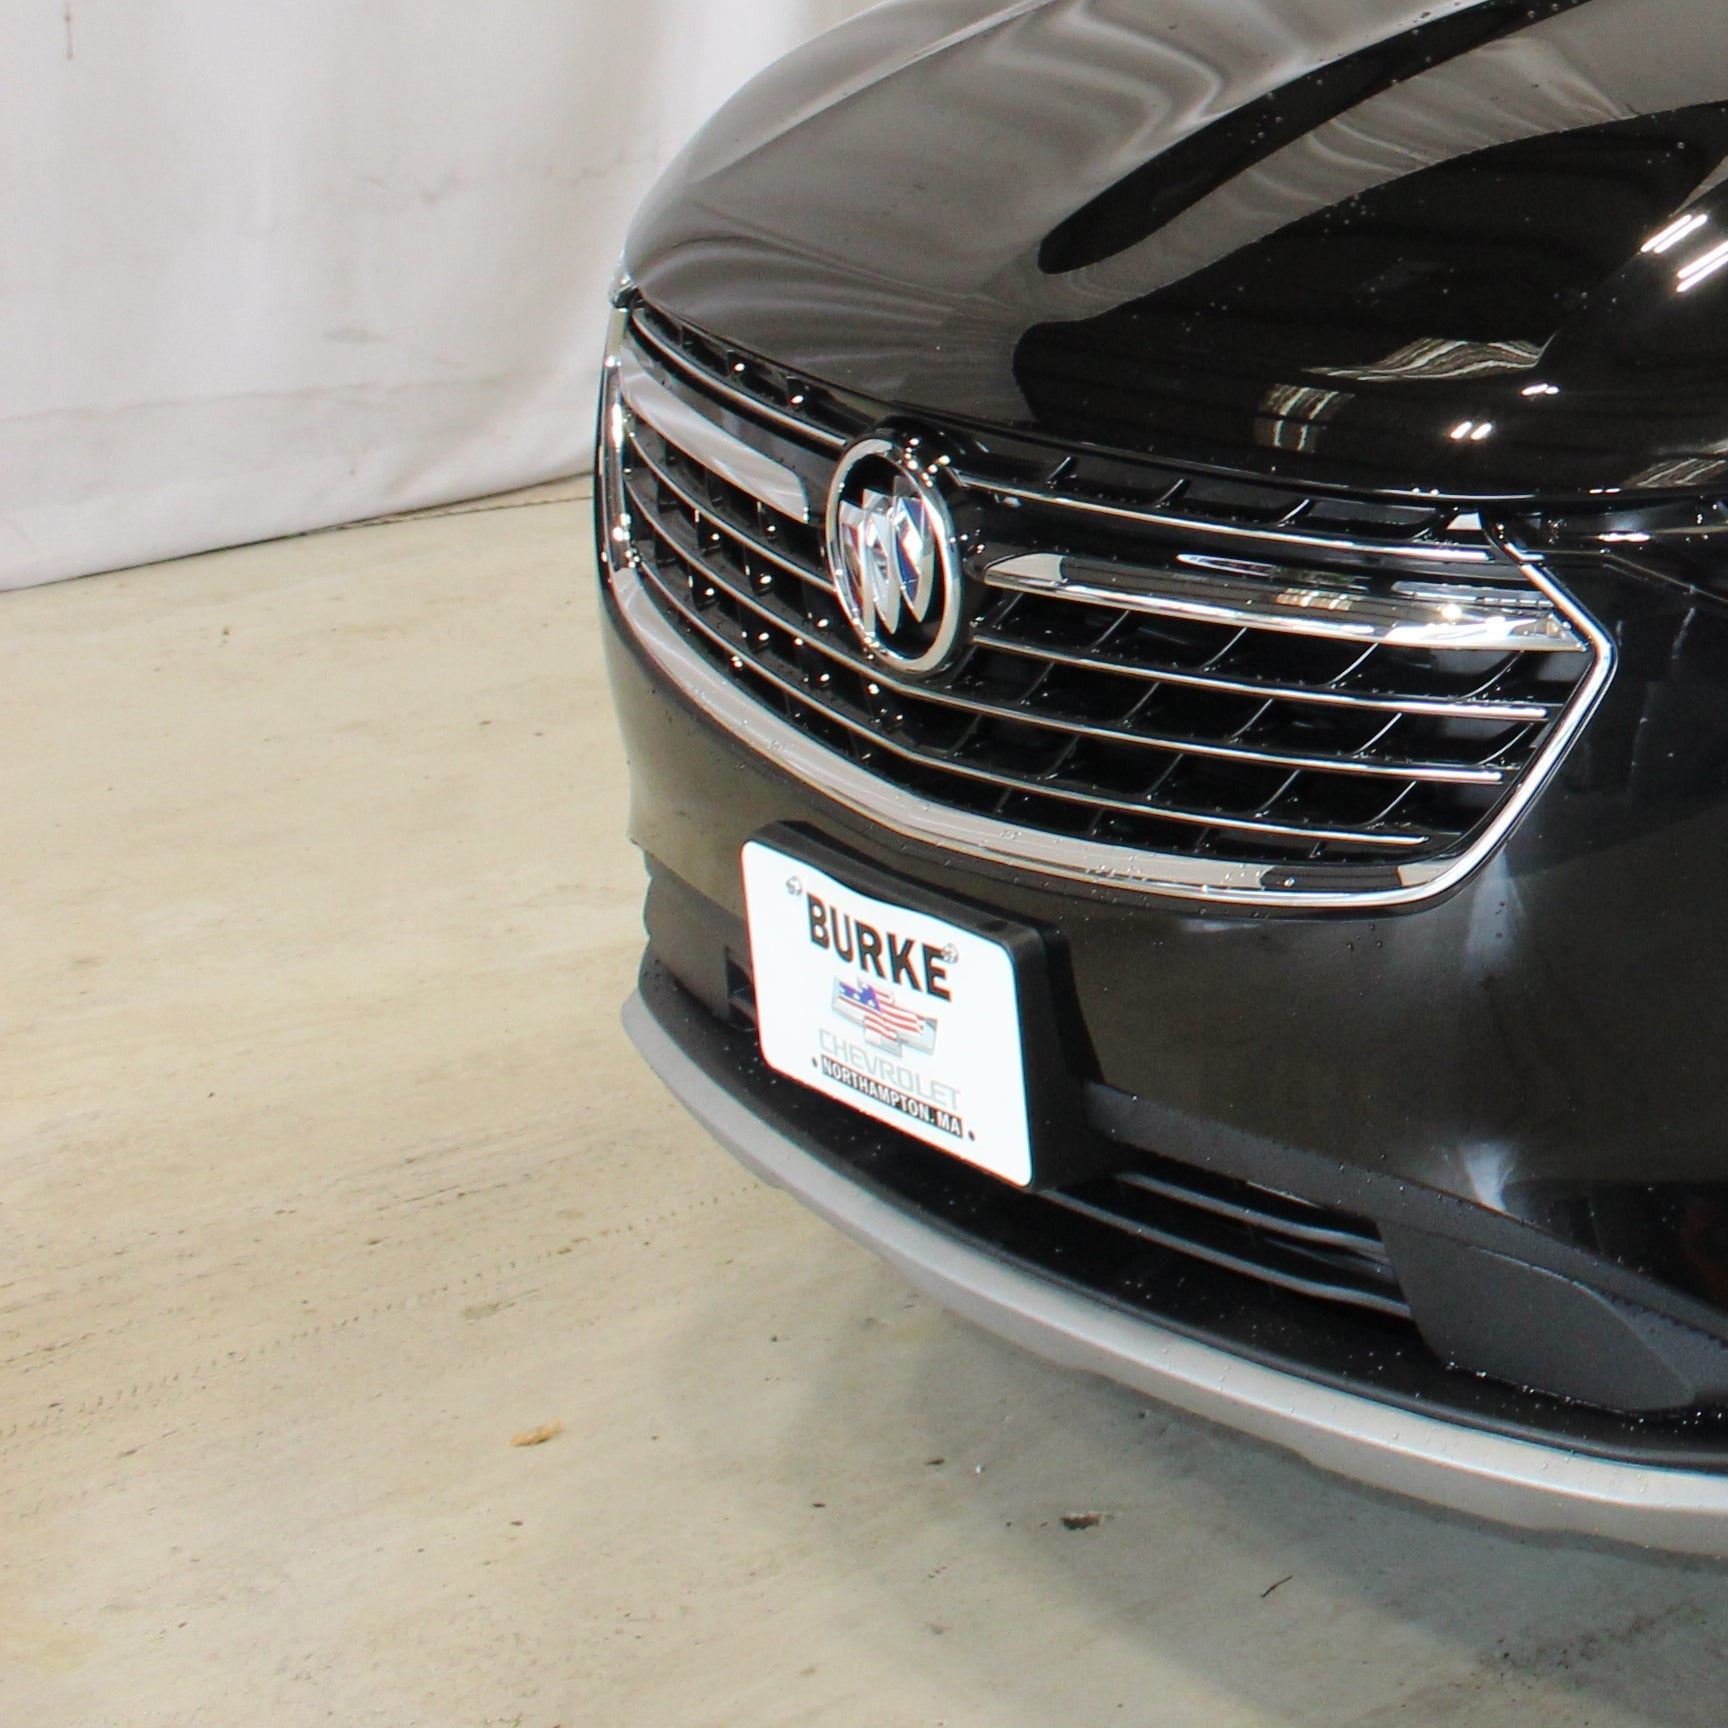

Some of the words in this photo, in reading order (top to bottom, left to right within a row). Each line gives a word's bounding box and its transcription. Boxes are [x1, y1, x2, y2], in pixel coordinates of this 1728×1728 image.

[806, 891, 952, 1002] BURKE
[819, 1027, 961, 1110] CHEVROLET
[936, 1109, 963, 1138] MA
